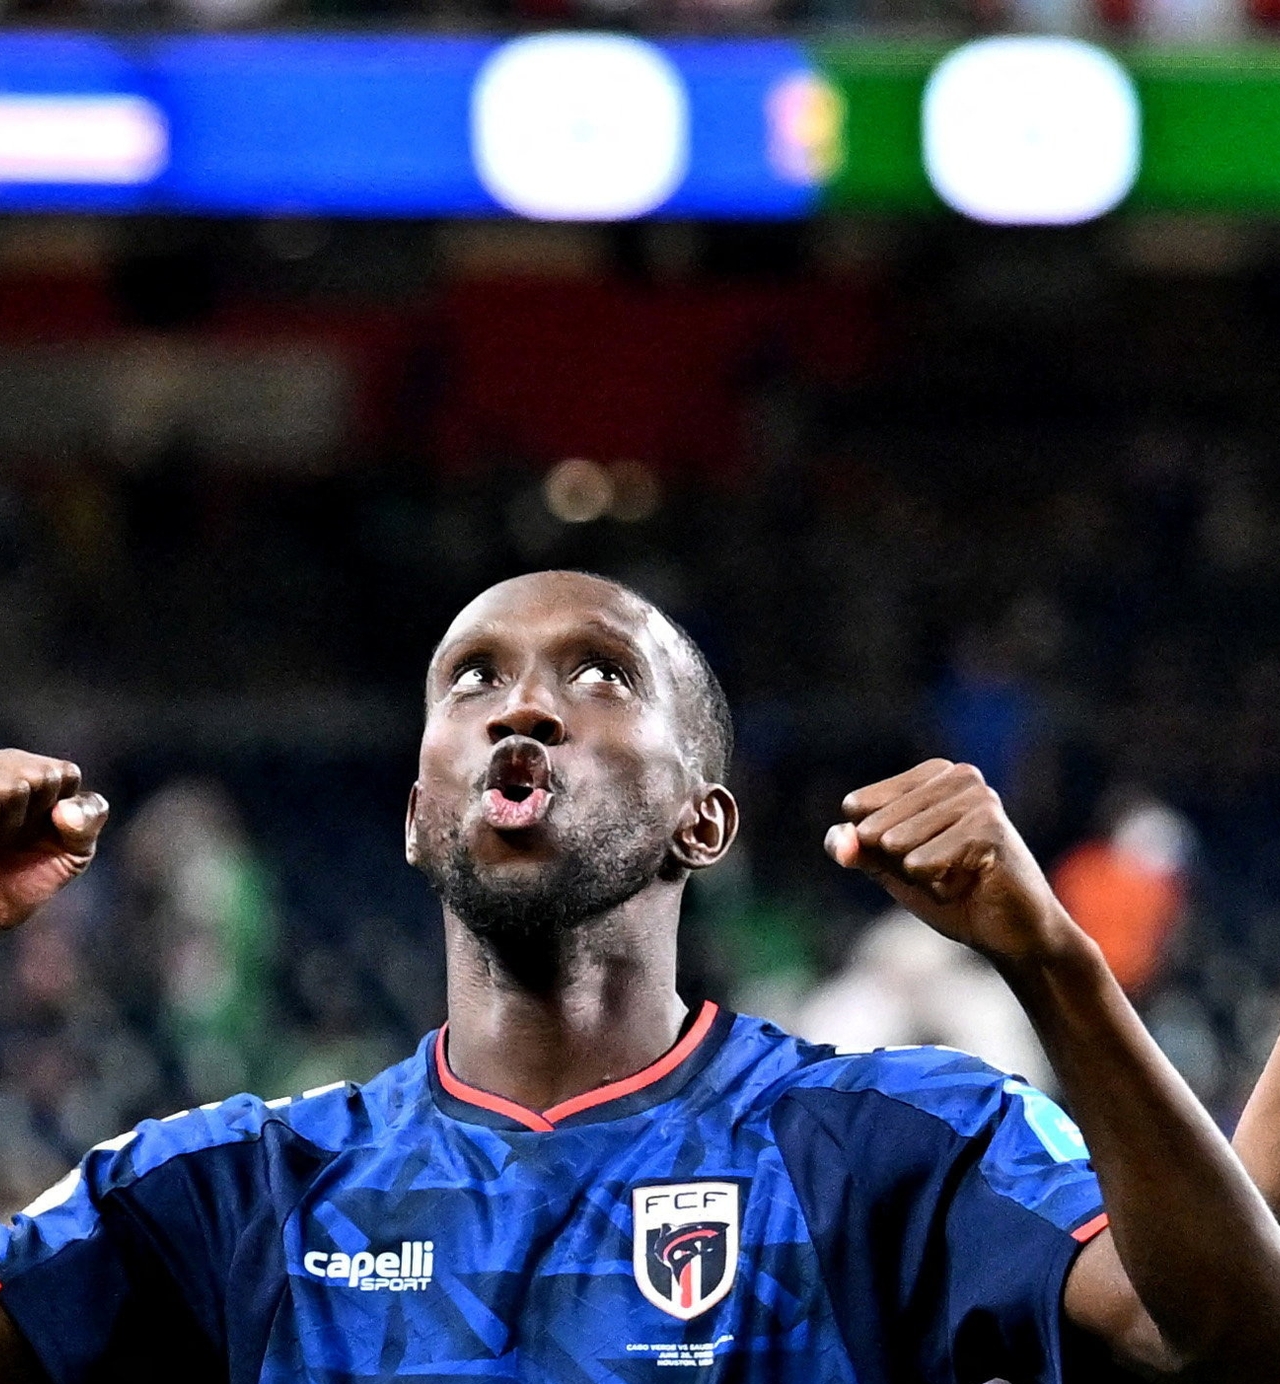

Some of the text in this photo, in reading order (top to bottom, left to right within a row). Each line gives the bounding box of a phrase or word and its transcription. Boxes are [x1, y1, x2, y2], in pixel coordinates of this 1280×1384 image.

[646, 1192, 728, 1213] FCF
[304, 1241, 434, 1287] capelli
[360, 1277, 432, 1291] SPORT
